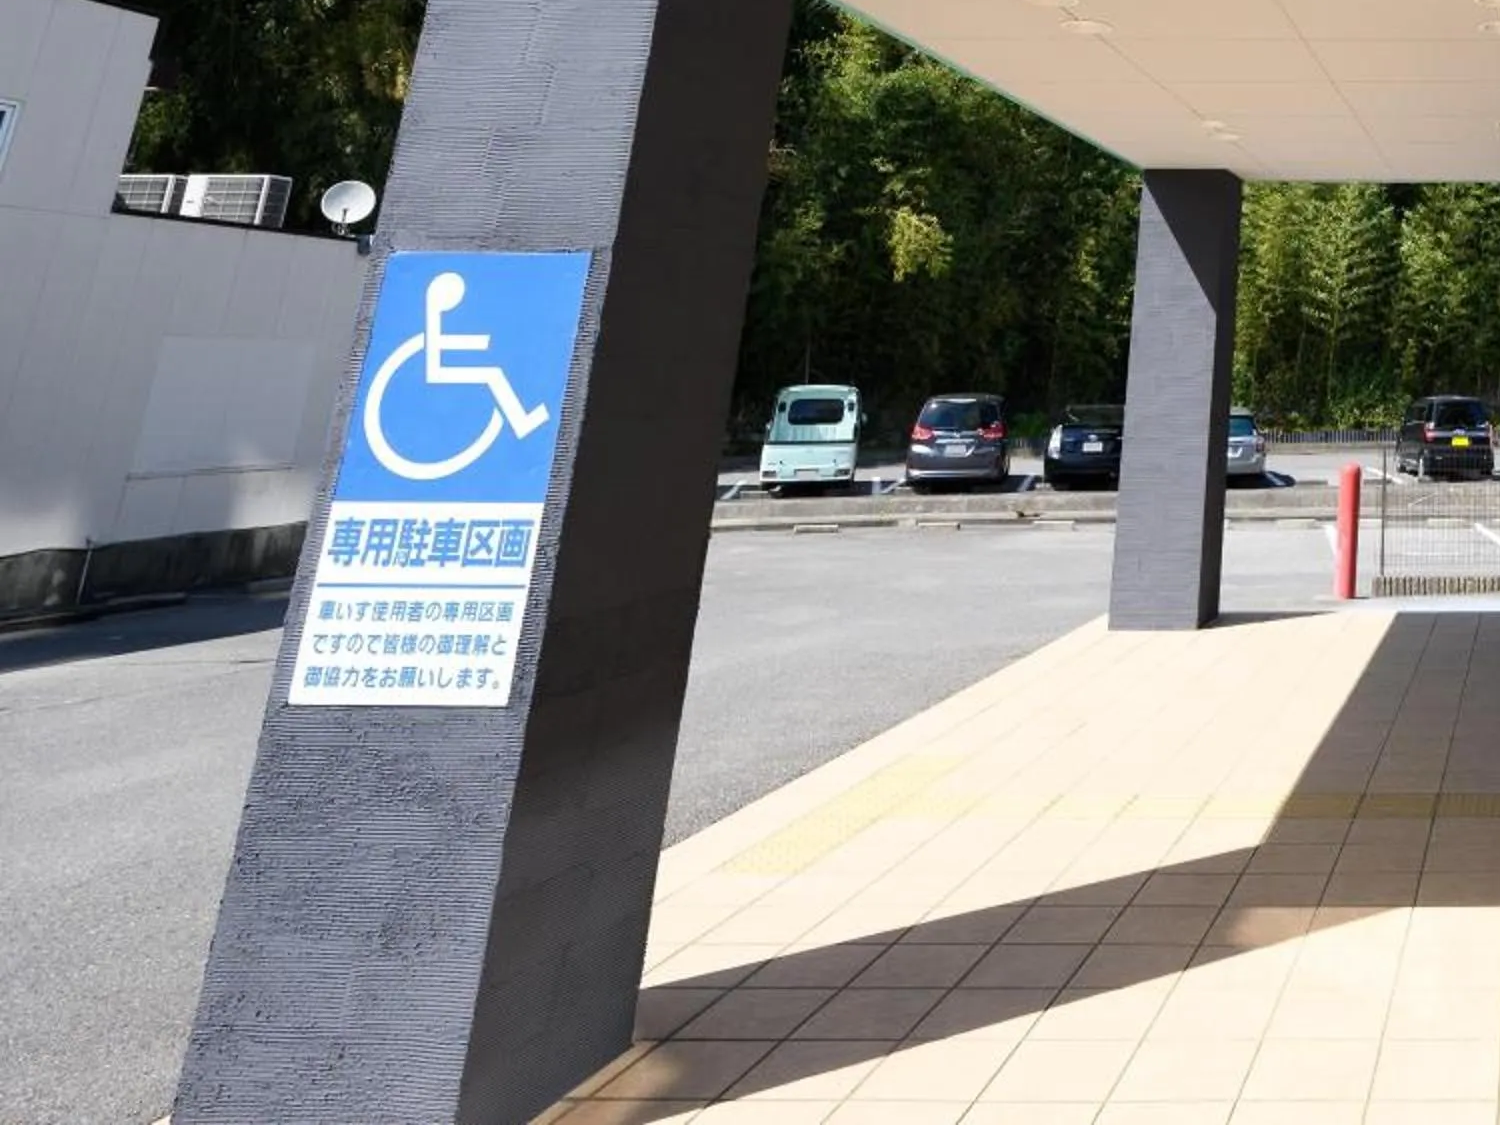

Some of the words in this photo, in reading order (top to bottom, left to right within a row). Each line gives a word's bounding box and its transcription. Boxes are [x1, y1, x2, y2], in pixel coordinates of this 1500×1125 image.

[327, 516, 535, 568] 専用駐車区画
[318, 600, 515, 623] 車いす使用者の専用区画
[313, 633, 508, 655] ですので皆様の御理解と
[303, 666, 500, 690] 御協力をお願いします。
